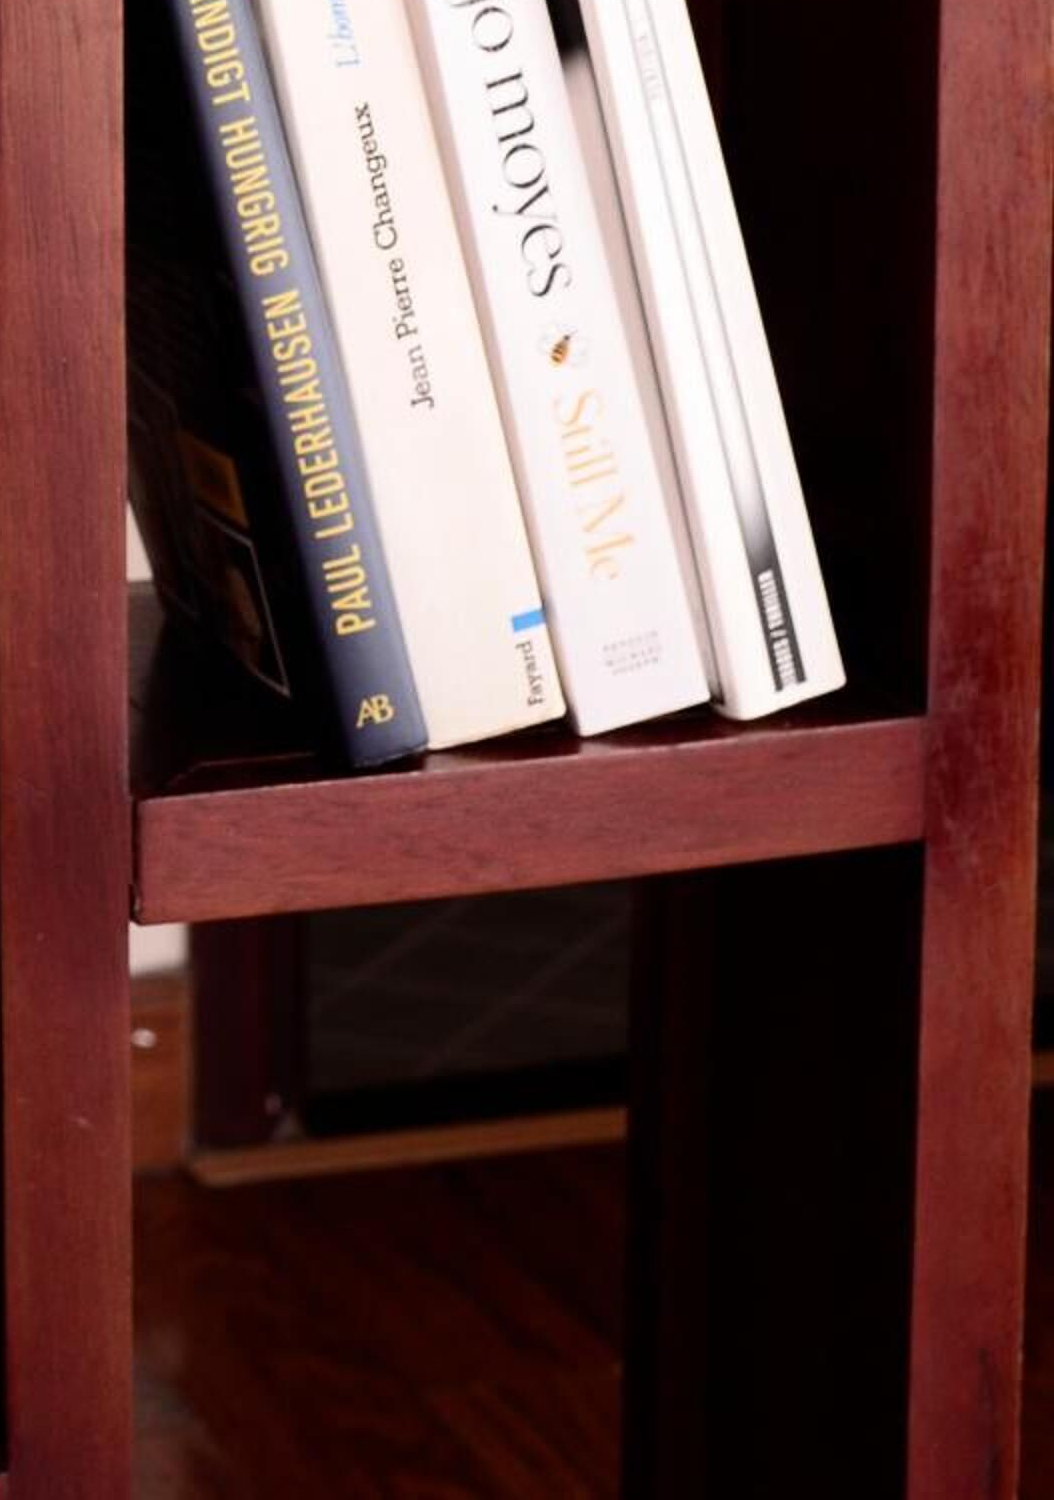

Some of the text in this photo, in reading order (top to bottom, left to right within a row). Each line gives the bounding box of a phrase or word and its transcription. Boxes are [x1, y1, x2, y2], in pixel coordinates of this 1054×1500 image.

[220, 116, 288, 276] HUNGRIG
[354, 102, 434, 408] Jean Pierre Changeux
[486, 68, 572, 298] moyes
[262, 289, 376, 635] PAUL LEDERHAUSEN
[553, 387, 619, 488] Still
[575, 492, 637, 581] Me
[356, 694, 395, 728] AB
